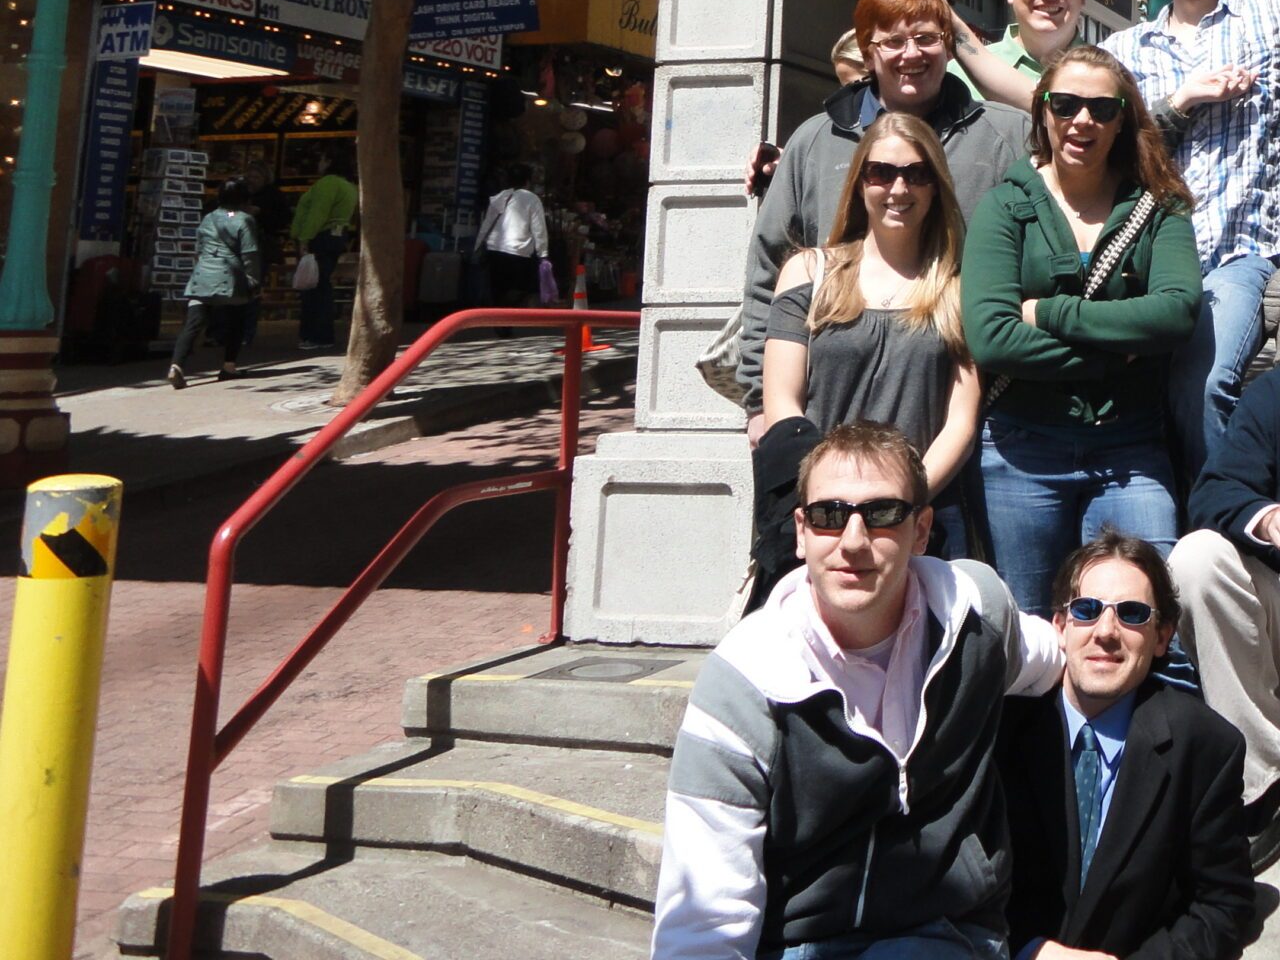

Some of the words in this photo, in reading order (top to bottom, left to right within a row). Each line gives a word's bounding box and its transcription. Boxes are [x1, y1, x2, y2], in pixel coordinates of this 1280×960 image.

[260, 2, 279, 20] 411
[436, 2, 461, 13] DRIVE
[463, 0, 486, 10] CARD
[462, 11, 496, 23] DIGITAL
[101, 30, 149, 54] ATM
[177, 22, 287, 64] Samsonite
[465, 42, 498, 65] VOLT
[297, 42, 363, 70] LUGGAGE
[313, 61, 345, 80] SALE
[403, 70, 459, 97] ELSEY
